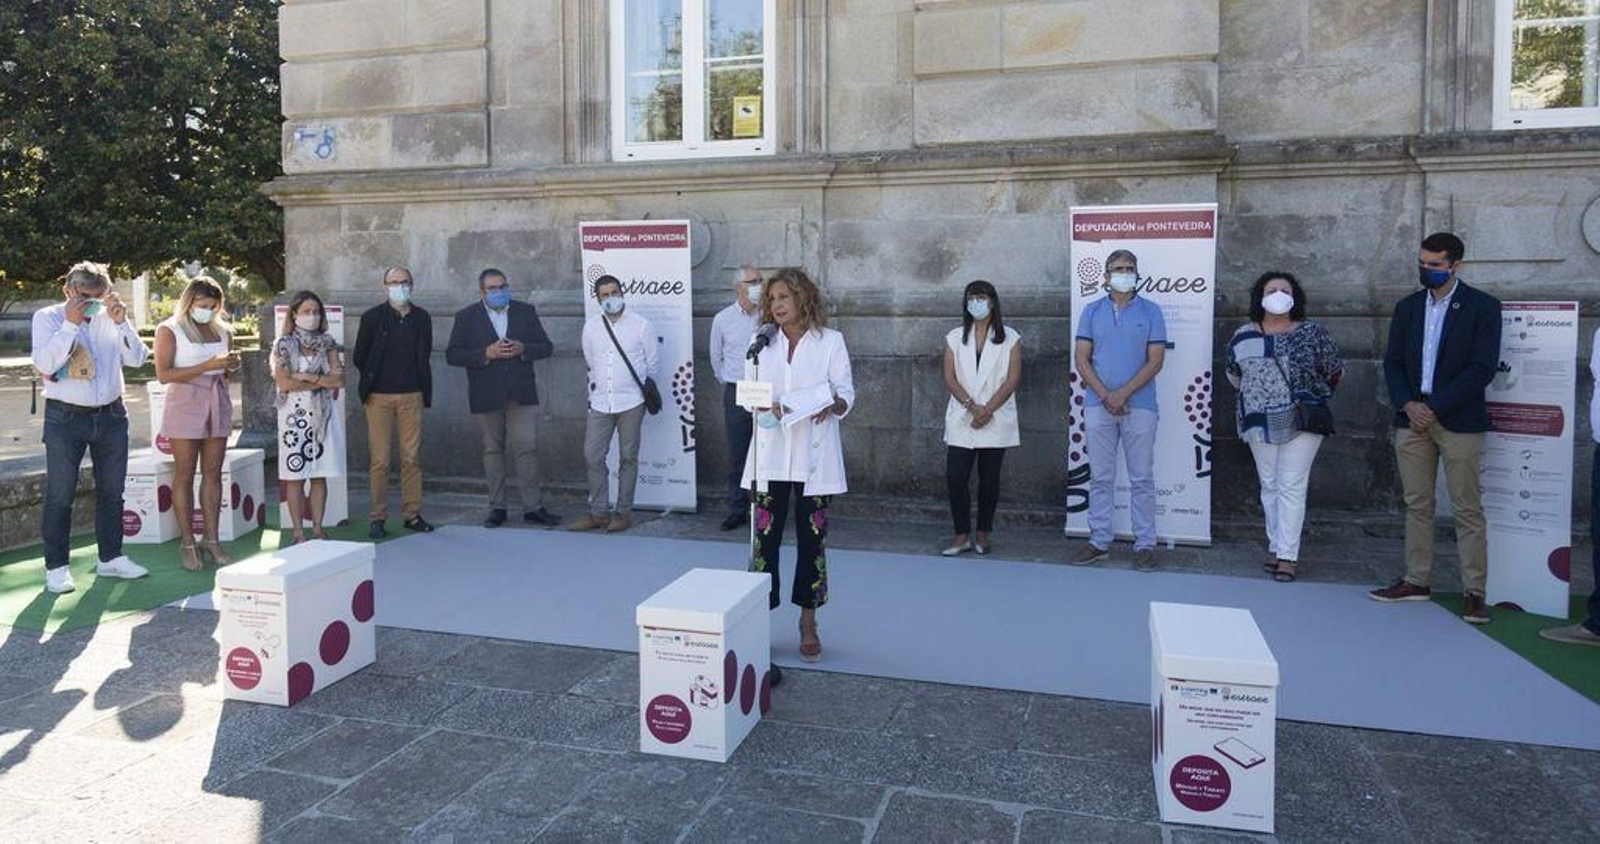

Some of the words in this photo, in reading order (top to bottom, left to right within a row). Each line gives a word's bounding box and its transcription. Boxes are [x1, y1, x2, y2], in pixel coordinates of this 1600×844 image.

[1074, 221, 1136, 231] DEPUTACIÓN
[1146, 220, 1212, 231] PONTEVEDRA
[583, 234, 630, 243] DEPUTACIÓN
[638, 233, 686, 242] PONTEVEDRA
[1182, 767, 1219, 776] DEPOSITA
